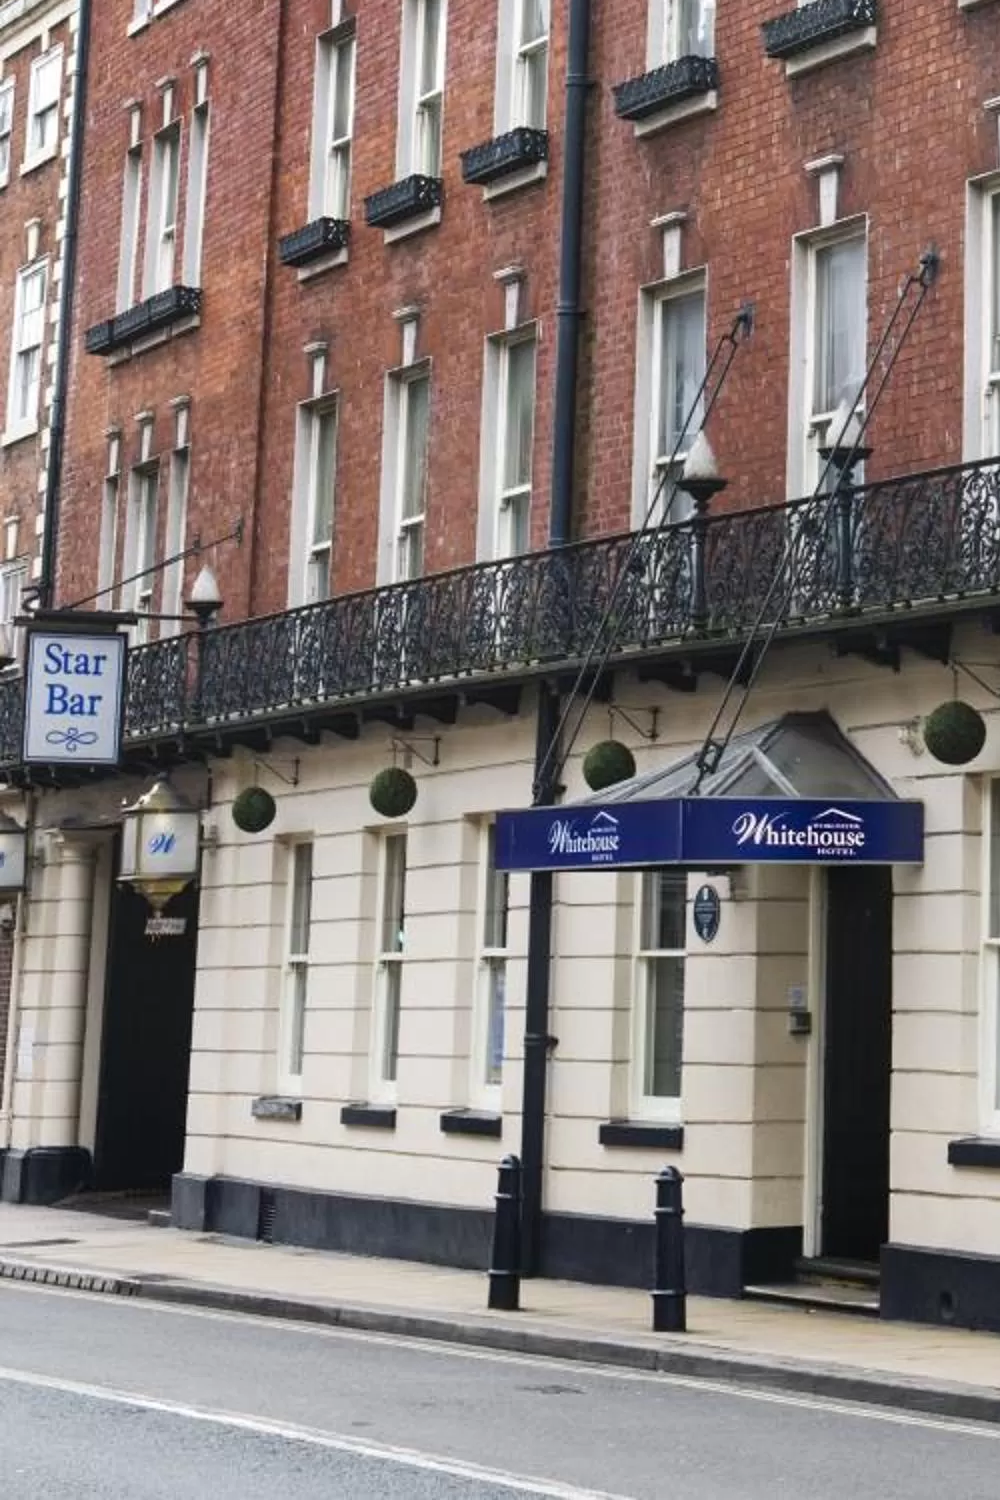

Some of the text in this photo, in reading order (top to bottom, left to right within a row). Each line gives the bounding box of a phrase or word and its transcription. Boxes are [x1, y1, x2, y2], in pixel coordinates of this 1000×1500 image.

[43, 642, 107, 676] Star
[44, 683, 103, 716] Bar
[548, 819, 619, 854] Whitehouse
[731, 811, 865, 846] Whitehouse
